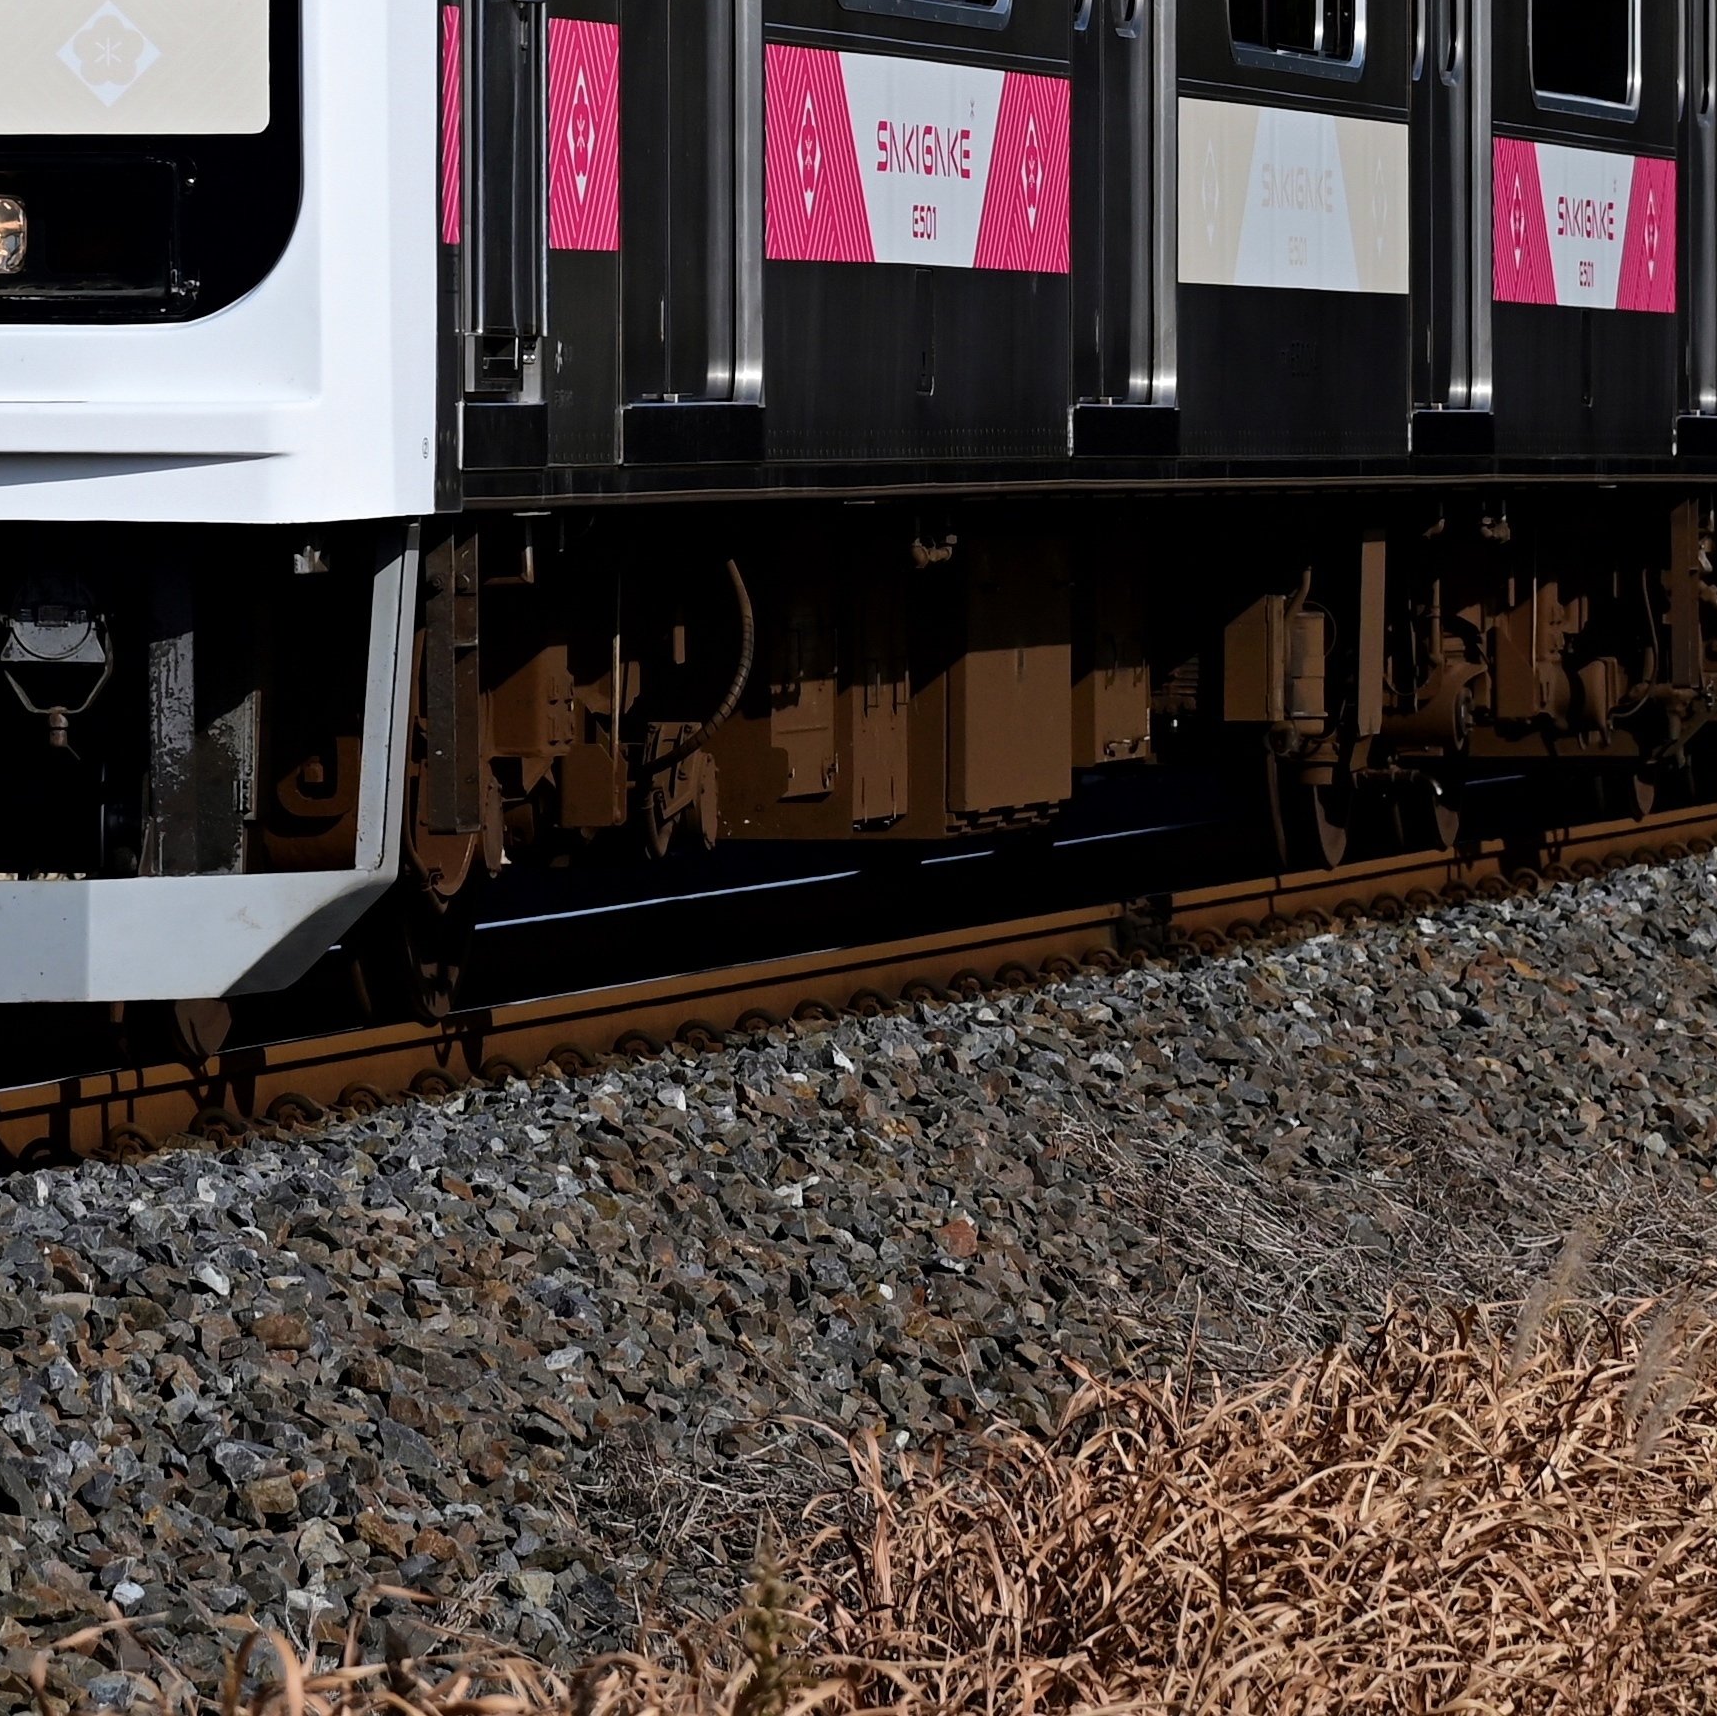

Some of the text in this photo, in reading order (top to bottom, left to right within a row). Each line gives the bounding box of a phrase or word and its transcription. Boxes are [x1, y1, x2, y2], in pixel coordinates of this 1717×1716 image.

[876, 120, 971, 179] SAKIGAKE
[912, 204, 937, 241] E501
[1557, 196, 1615, 241] SAKIGAKE
